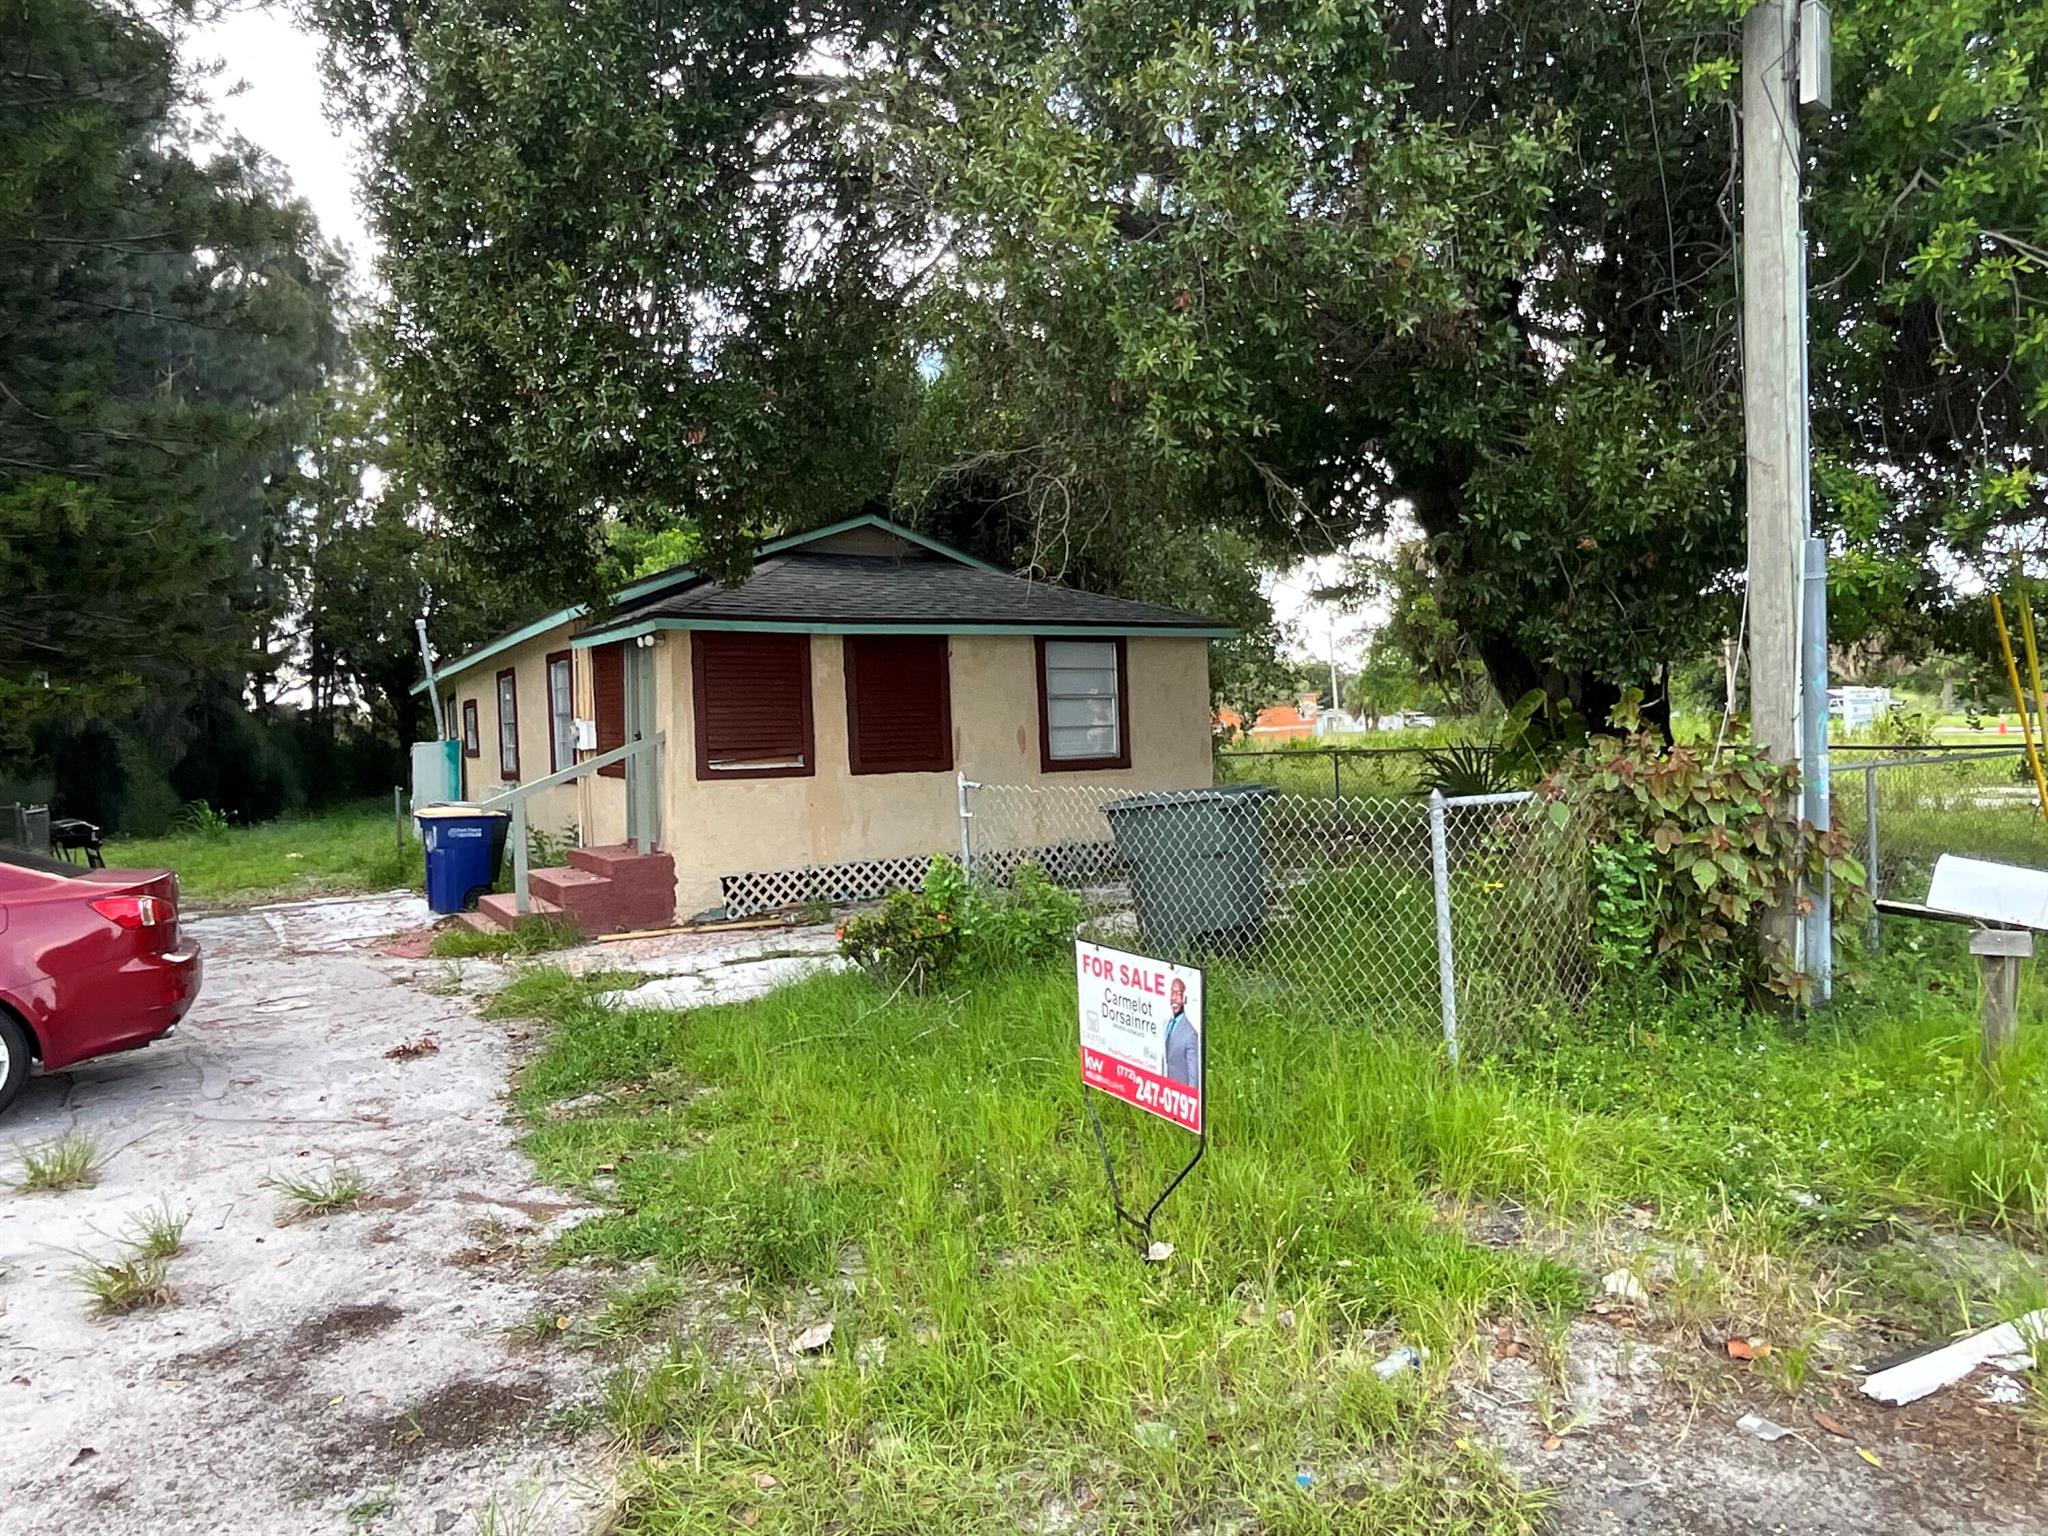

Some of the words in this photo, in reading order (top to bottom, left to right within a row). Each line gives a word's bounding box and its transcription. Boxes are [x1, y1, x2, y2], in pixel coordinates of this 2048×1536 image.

[1082, 954, 1114, 982] FOR
[1120, 965, 1165, 996] SALE
[1101, 1002, 1157, 1035] Dorsainrre
[1104, 987, 1153, 1017] Carmelot
[1135, 1075, 1198, 1123] 247-0797
